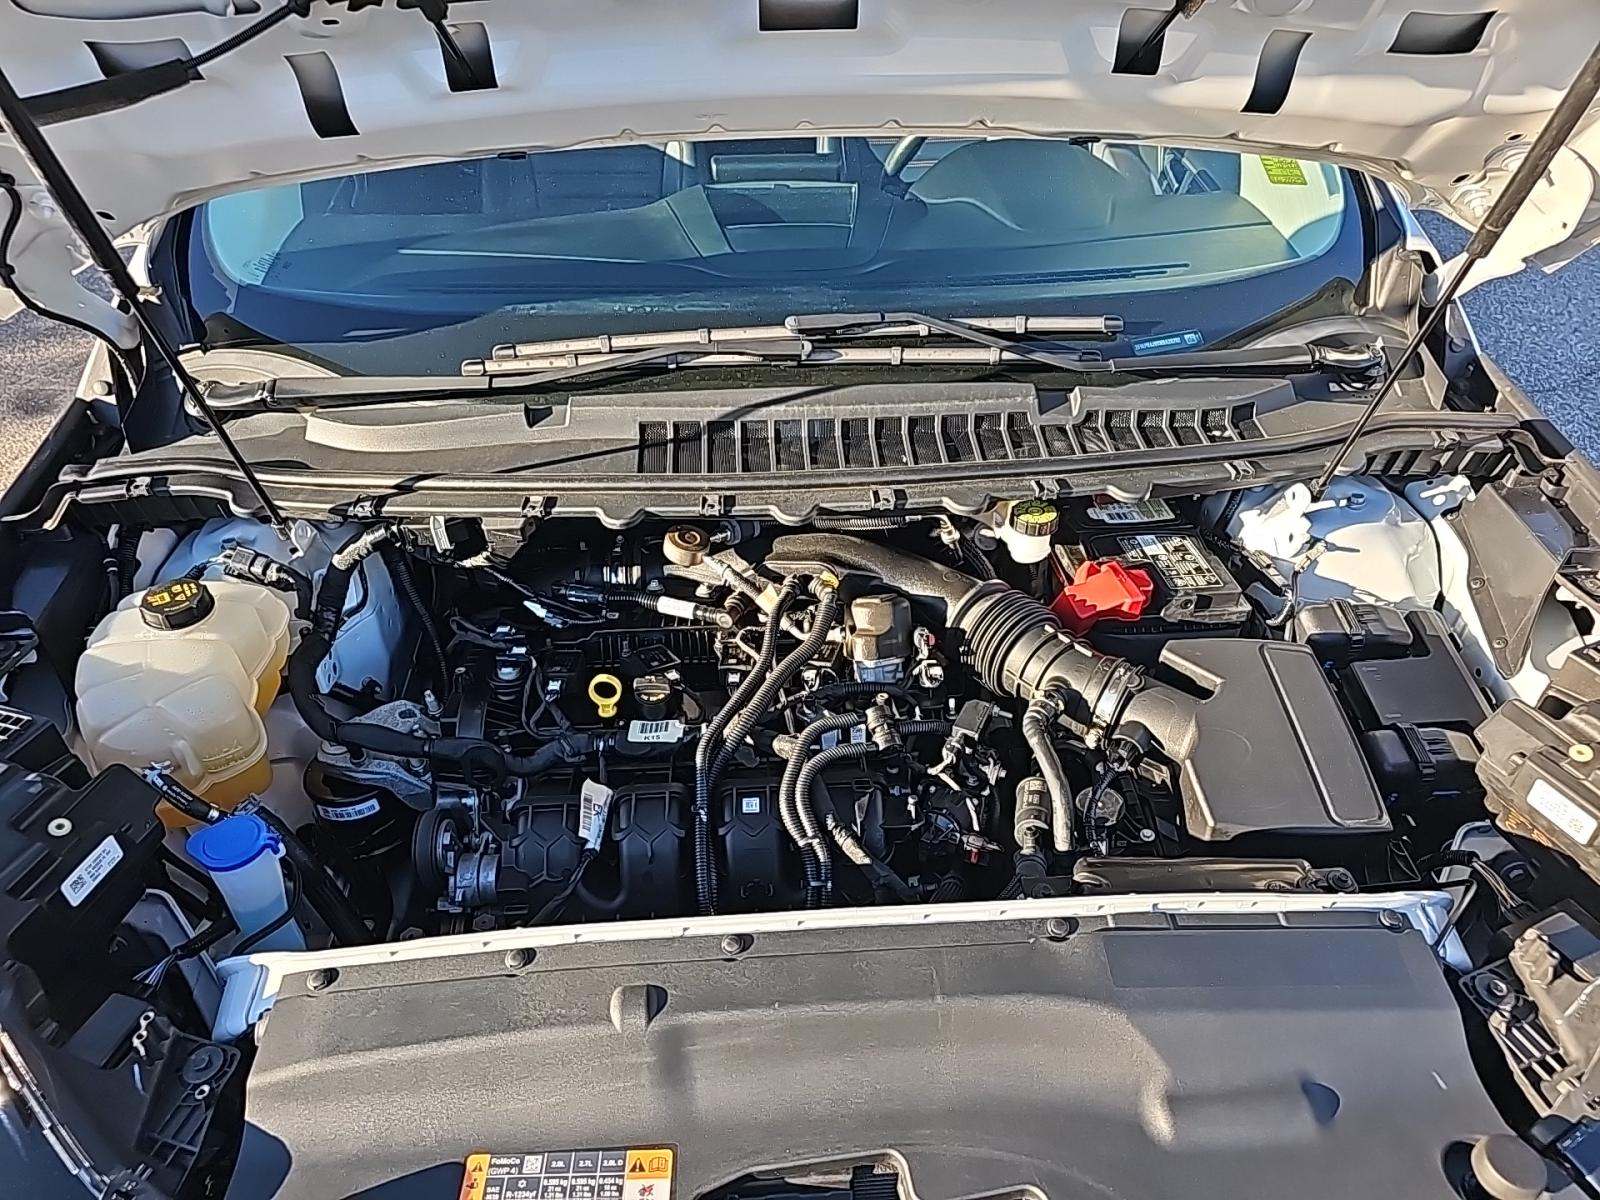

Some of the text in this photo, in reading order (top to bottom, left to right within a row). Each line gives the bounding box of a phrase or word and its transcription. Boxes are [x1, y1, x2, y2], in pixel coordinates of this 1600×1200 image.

[491, 1157, 520, 1165] FoMoCo
[578, 1159, 593, 1167] 2.7L
[488, 1166, 519, 1176] (GWP 4)
[505, 1190, 537, 1199] R-1234yf
